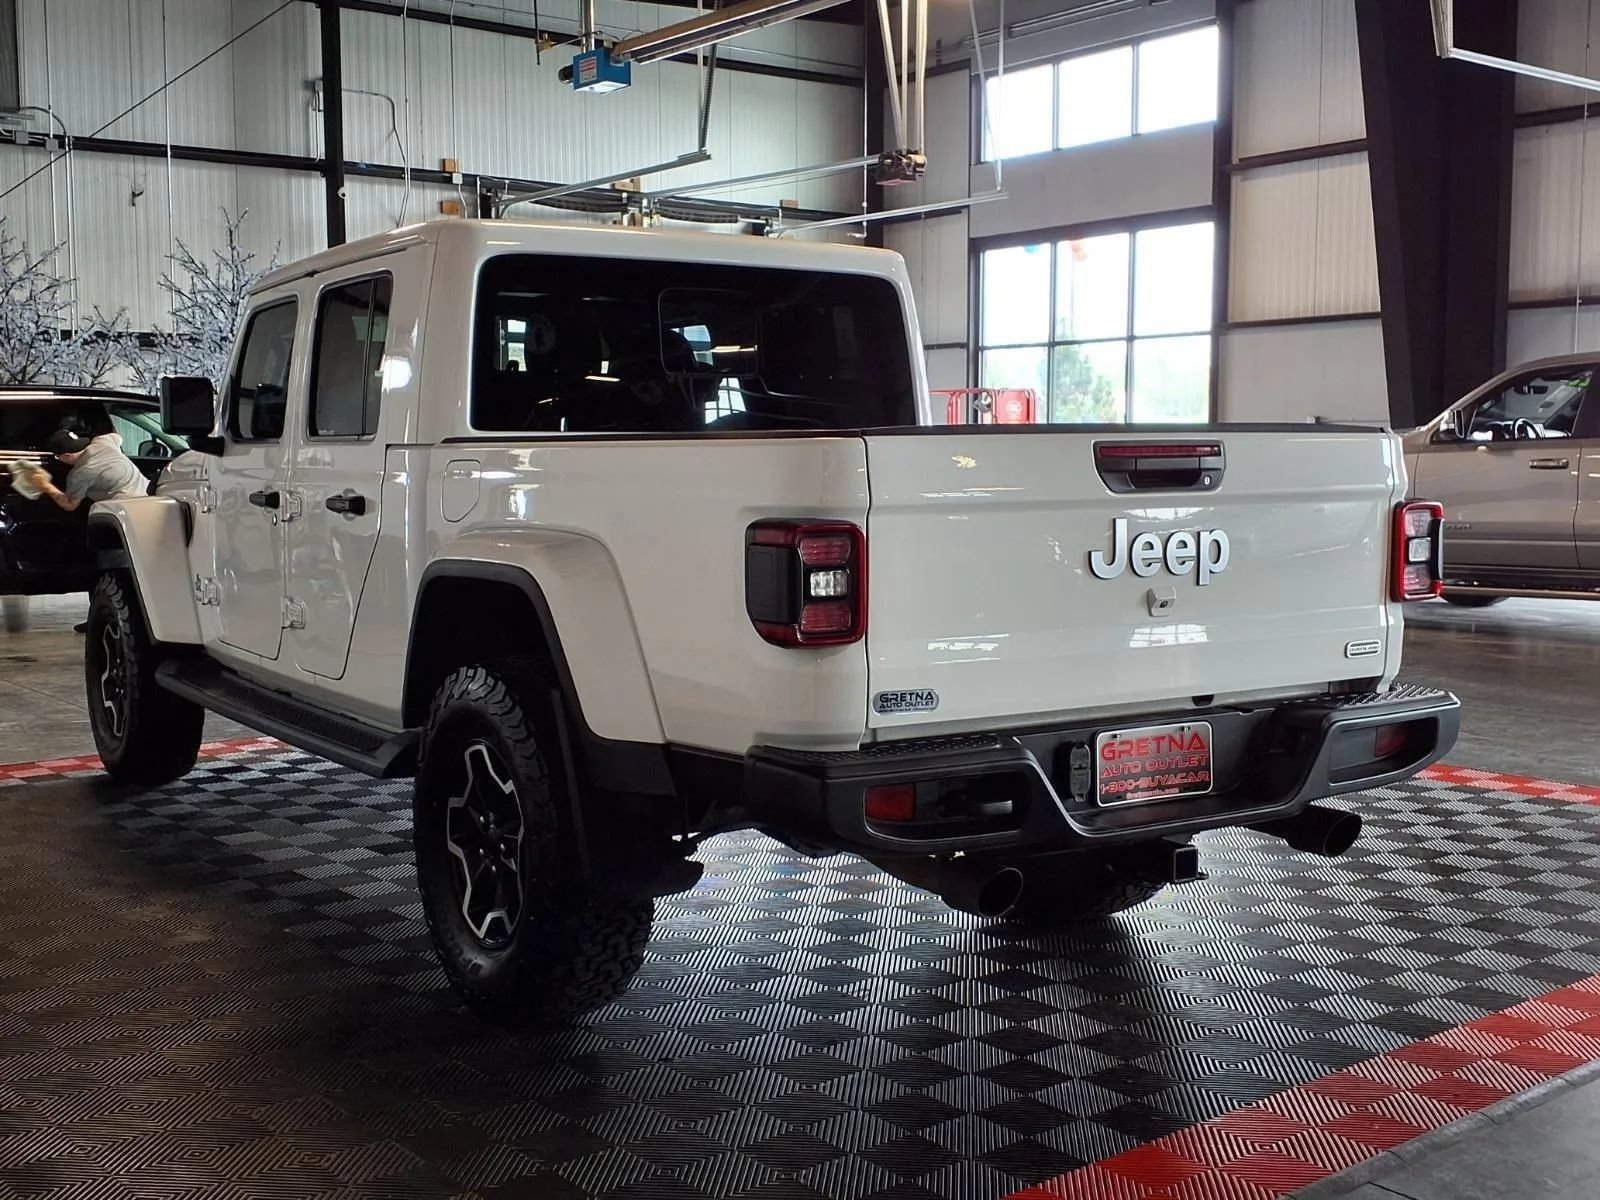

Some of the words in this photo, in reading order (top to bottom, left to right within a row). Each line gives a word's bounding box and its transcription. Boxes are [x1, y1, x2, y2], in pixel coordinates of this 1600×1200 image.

[1089, 518, 1230, 586] Jeep
[880, 692, 934, 703] GRETNA
[1101, 732, 1208, 762] GRETNA
[1102, 761, 1141, 778] AUTO
[1145, 754, 1208, 771] OUTLET
[1100, 771, 1210, 795] 1-800-BUYACAR
